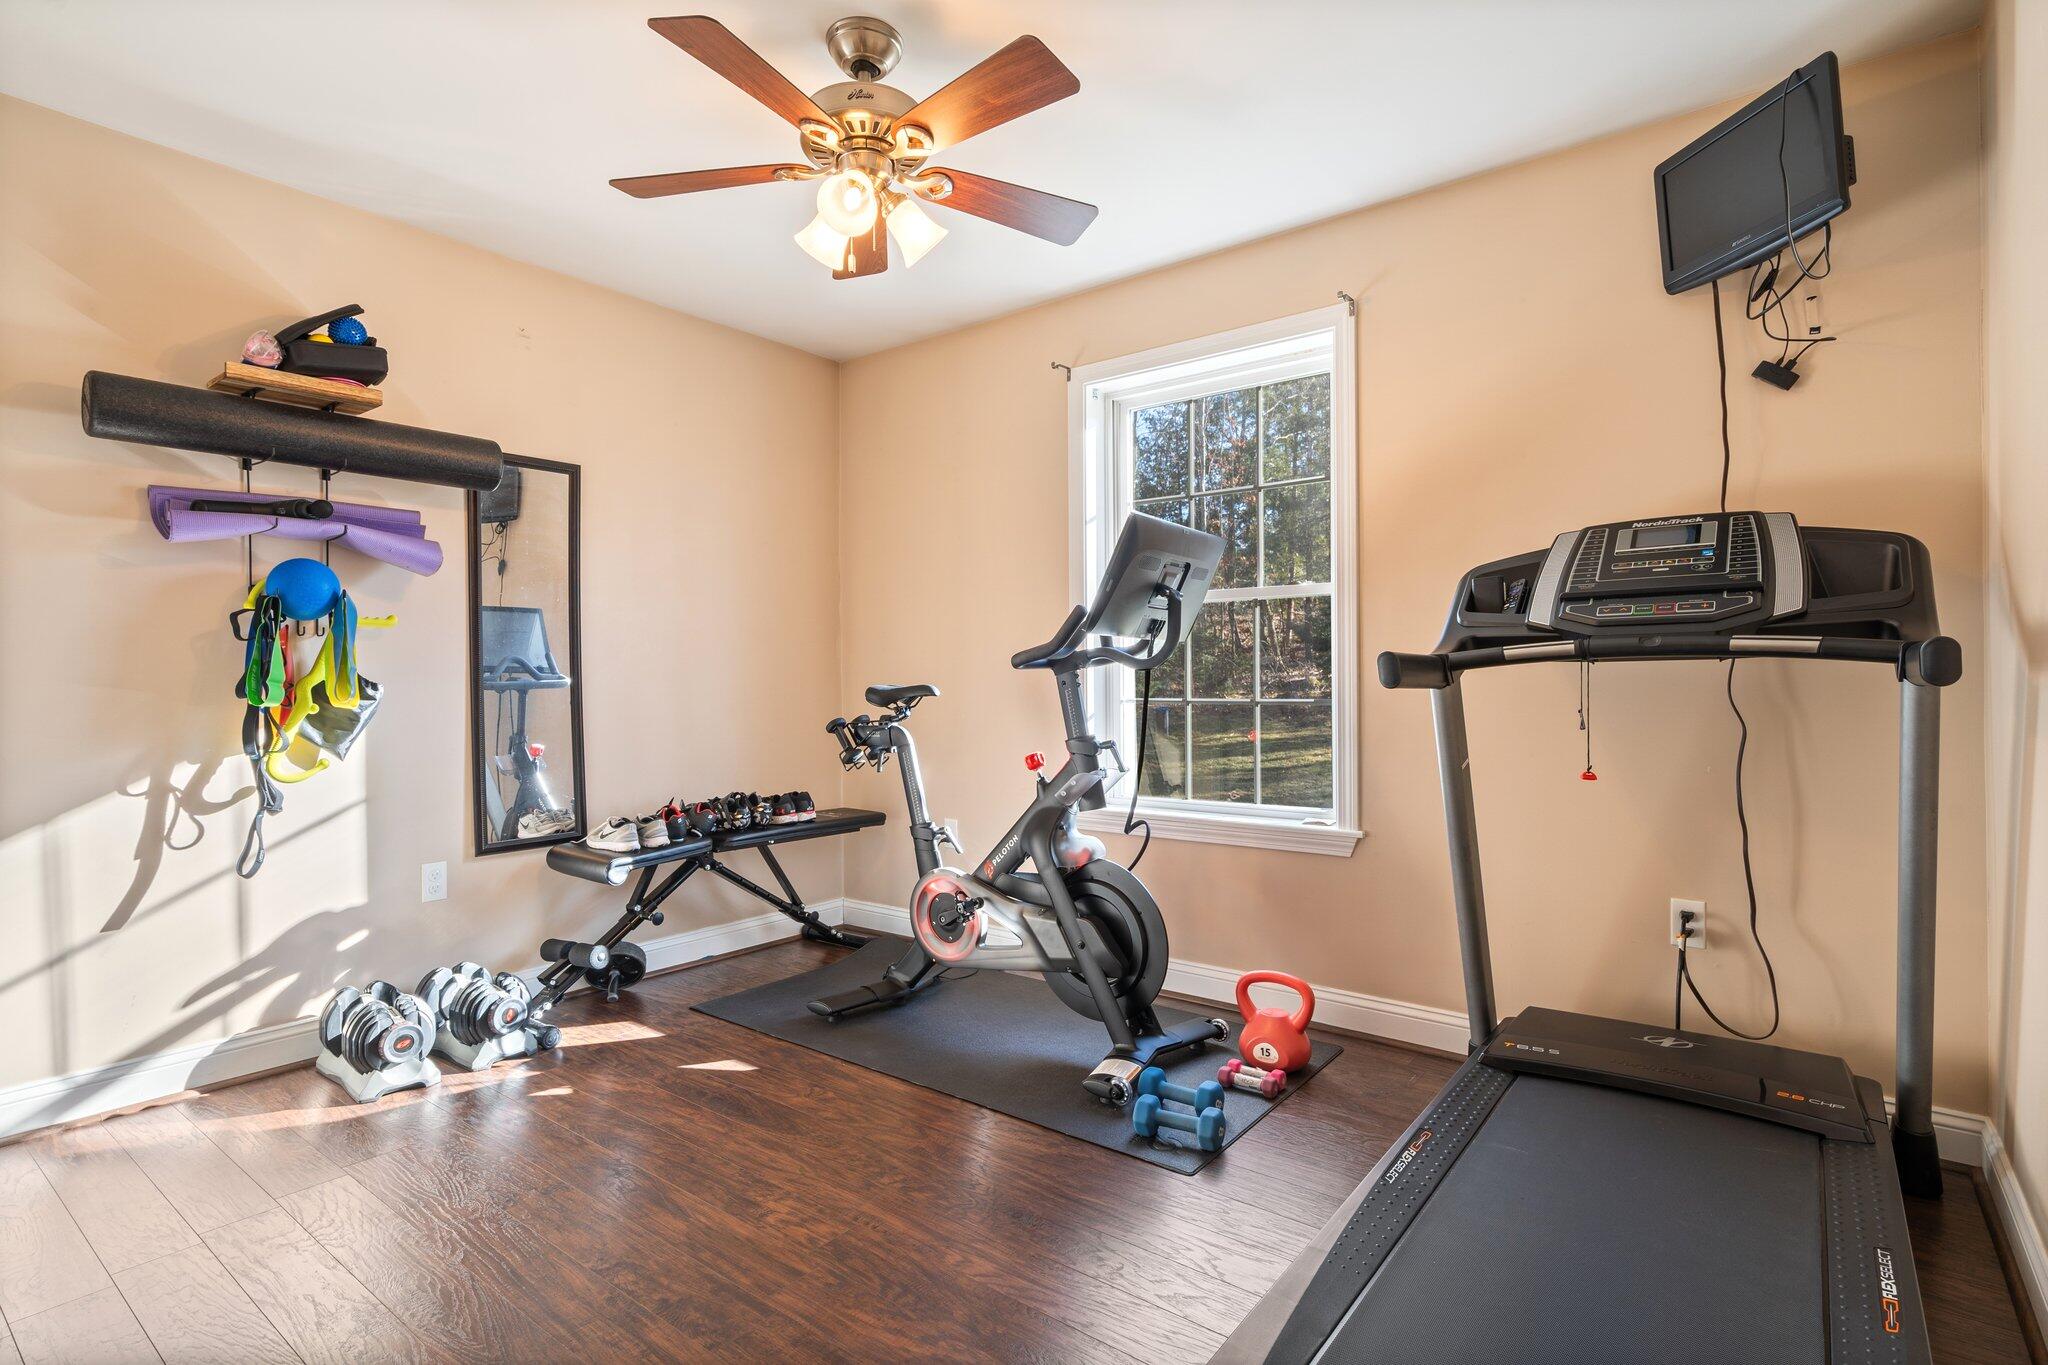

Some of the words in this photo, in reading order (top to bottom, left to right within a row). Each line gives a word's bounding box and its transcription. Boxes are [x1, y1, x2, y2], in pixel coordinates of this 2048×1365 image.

[1631, 516, 1704, 529] NordicTrack
[991, 834, 1019, 866] PELOTON
[1260, 1047, 1271, 1058] 15
